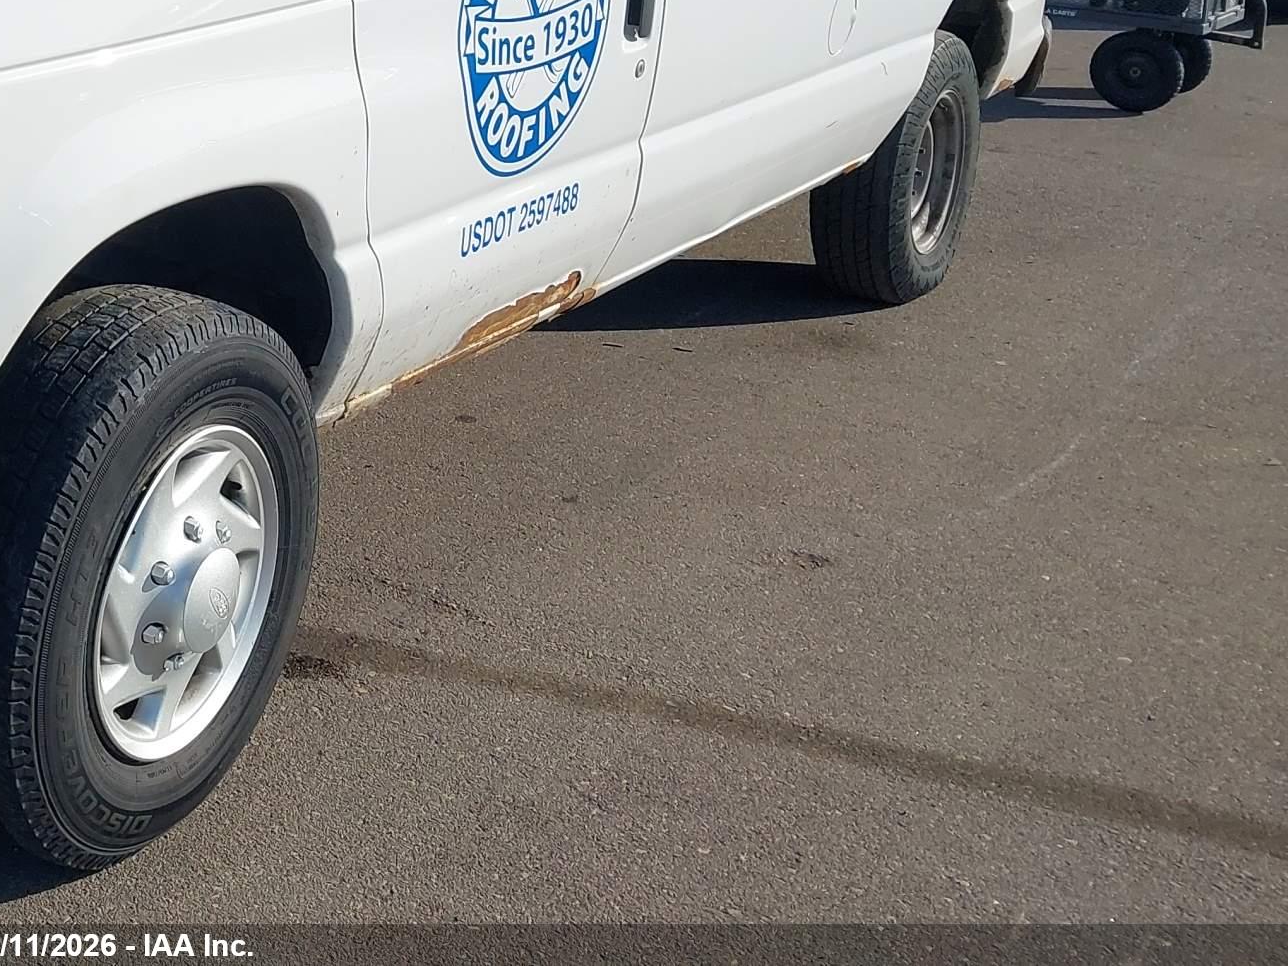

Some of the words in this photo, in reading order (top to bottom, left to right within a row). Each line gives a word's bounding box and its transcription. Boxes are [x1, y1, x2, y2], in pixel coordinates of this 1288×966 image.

[477, 25, 535, 67] Since
[543, 11, 594, 57] 1930
[476, 51, 590, 159] ROOFING
[460, 207, 516, 258] USDOT
[517, 182, 580, 234] 2597488
